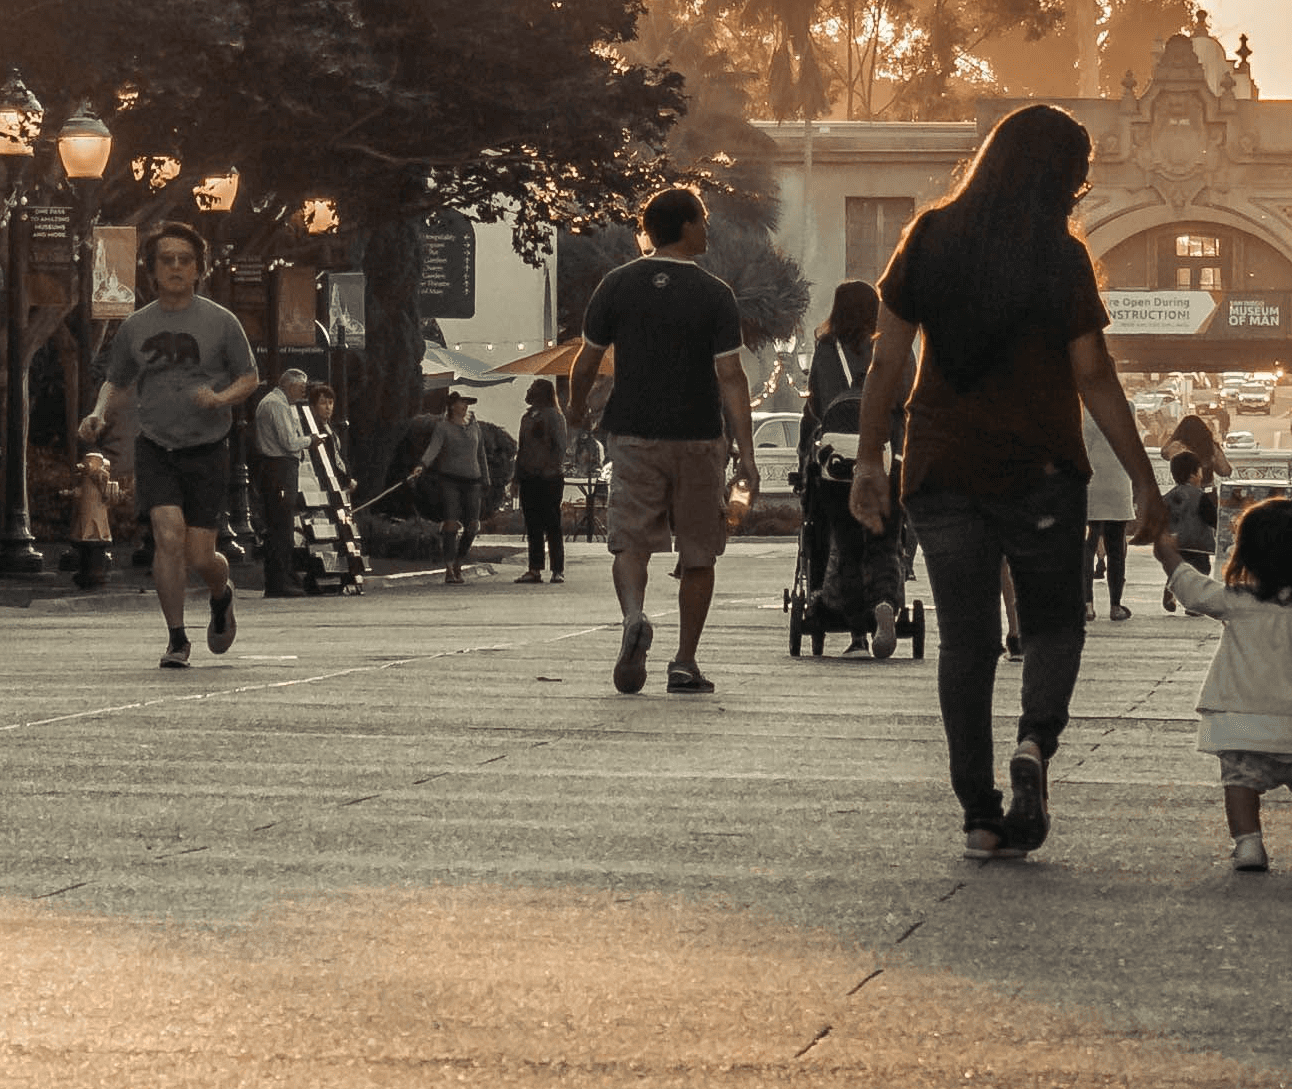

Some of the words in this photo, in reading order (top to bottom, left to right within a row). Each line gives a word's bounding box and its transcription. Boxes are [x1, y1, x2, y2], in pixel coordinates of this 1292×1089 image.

[1122, 297, 1151, 308] Open
[1154, 297, 1190, 308] During
[1230, 306, 1279, 316] MUSEUM
[1229, 315, 1247, 326] OF
[1249, 316, 1280, 326] MAN
